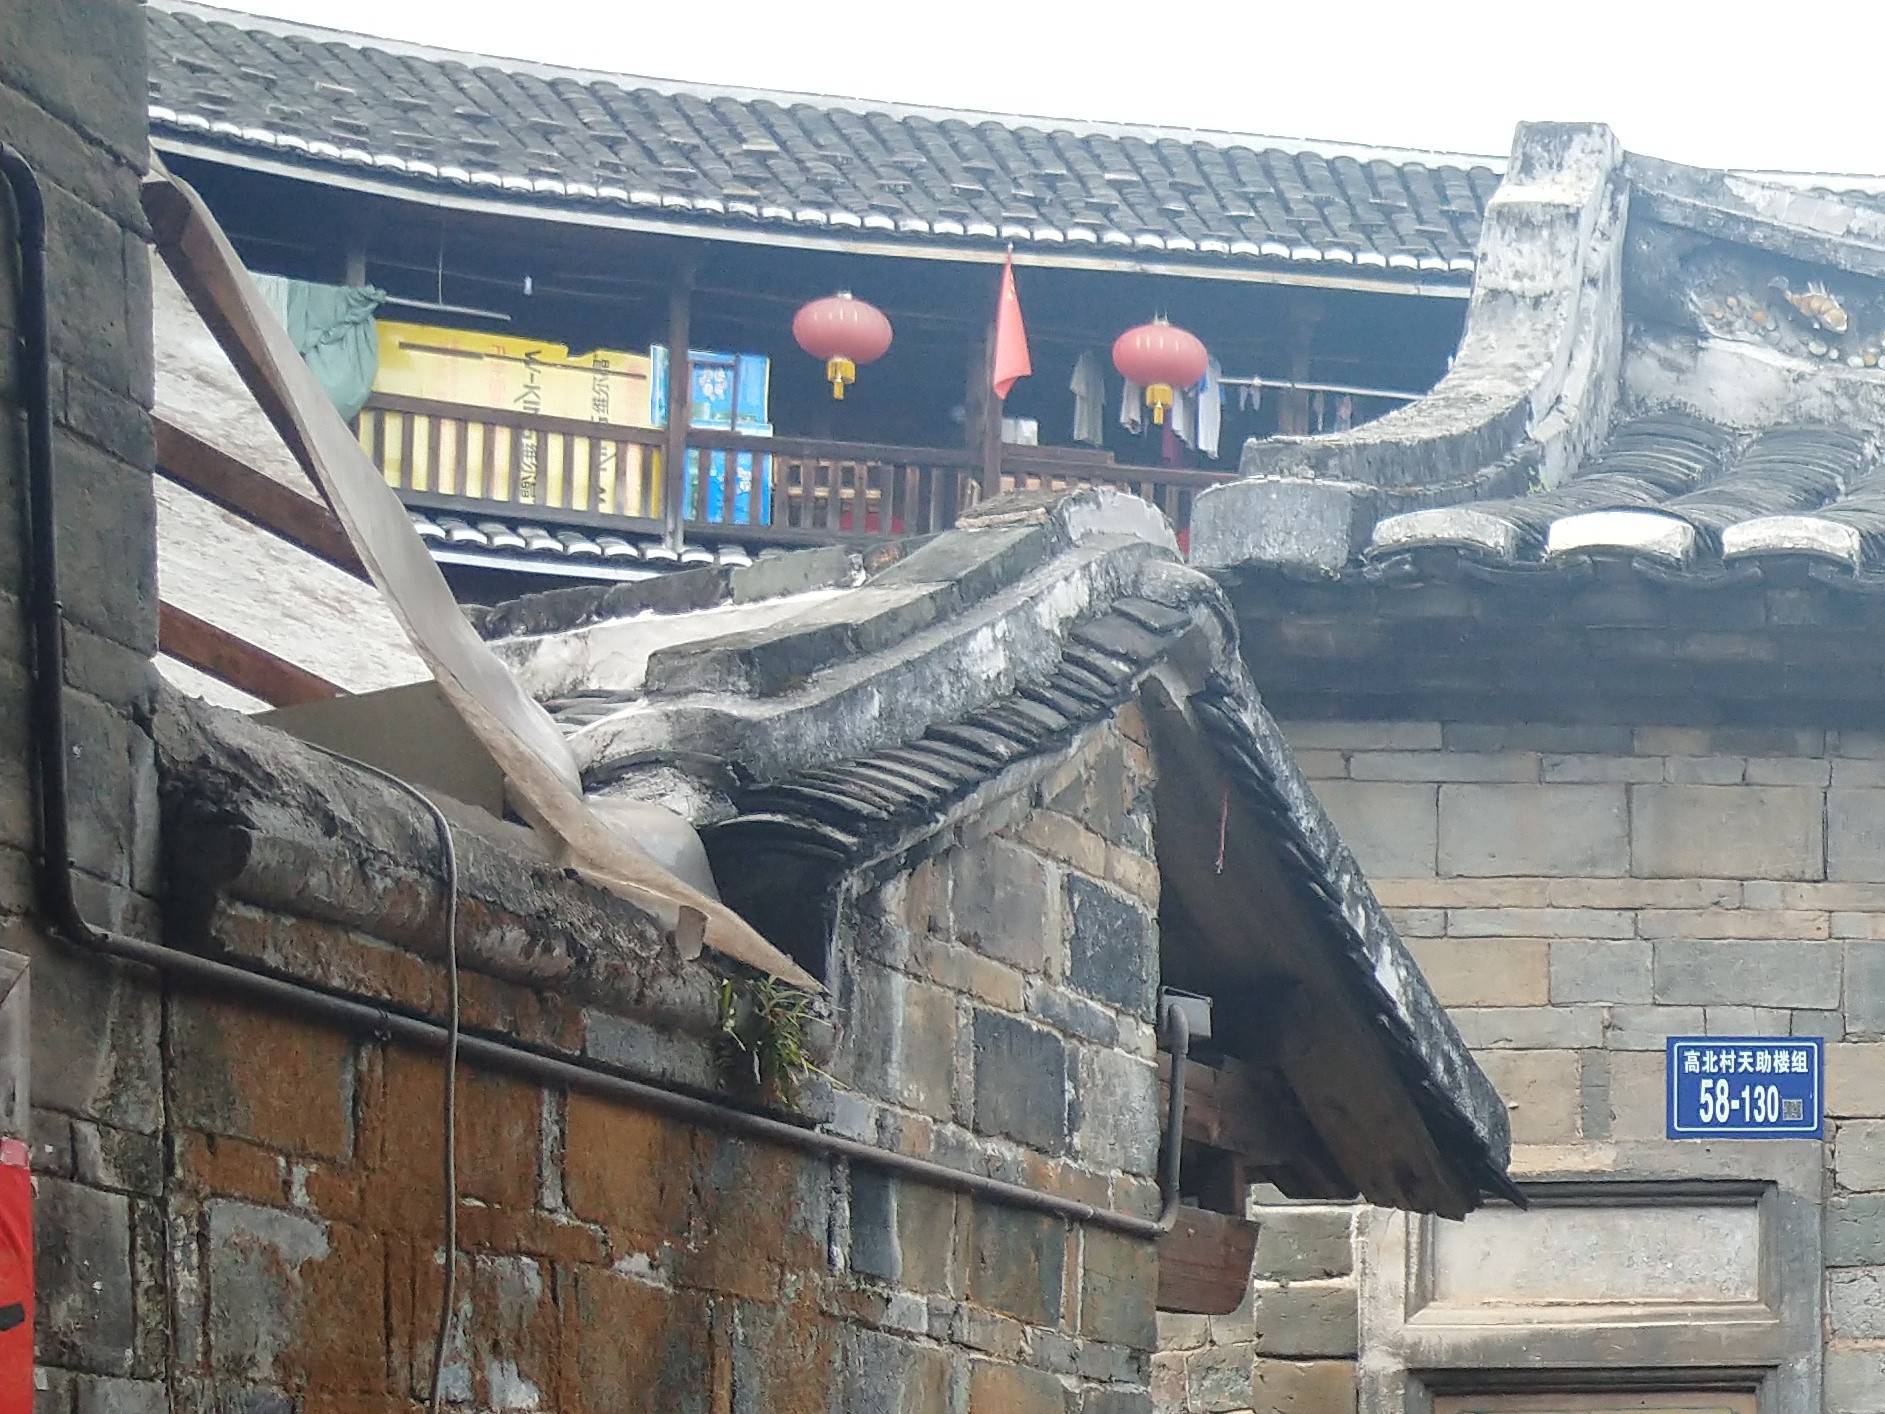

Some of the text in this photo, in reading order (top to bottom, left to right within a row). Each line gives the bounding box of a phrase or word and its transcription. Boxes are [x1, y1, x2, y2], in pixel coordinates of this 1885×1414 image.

[1684, 1050, 1809, 1074] 高北村天助楼组
[1699, 1078, 1779, 1123] 58-130
